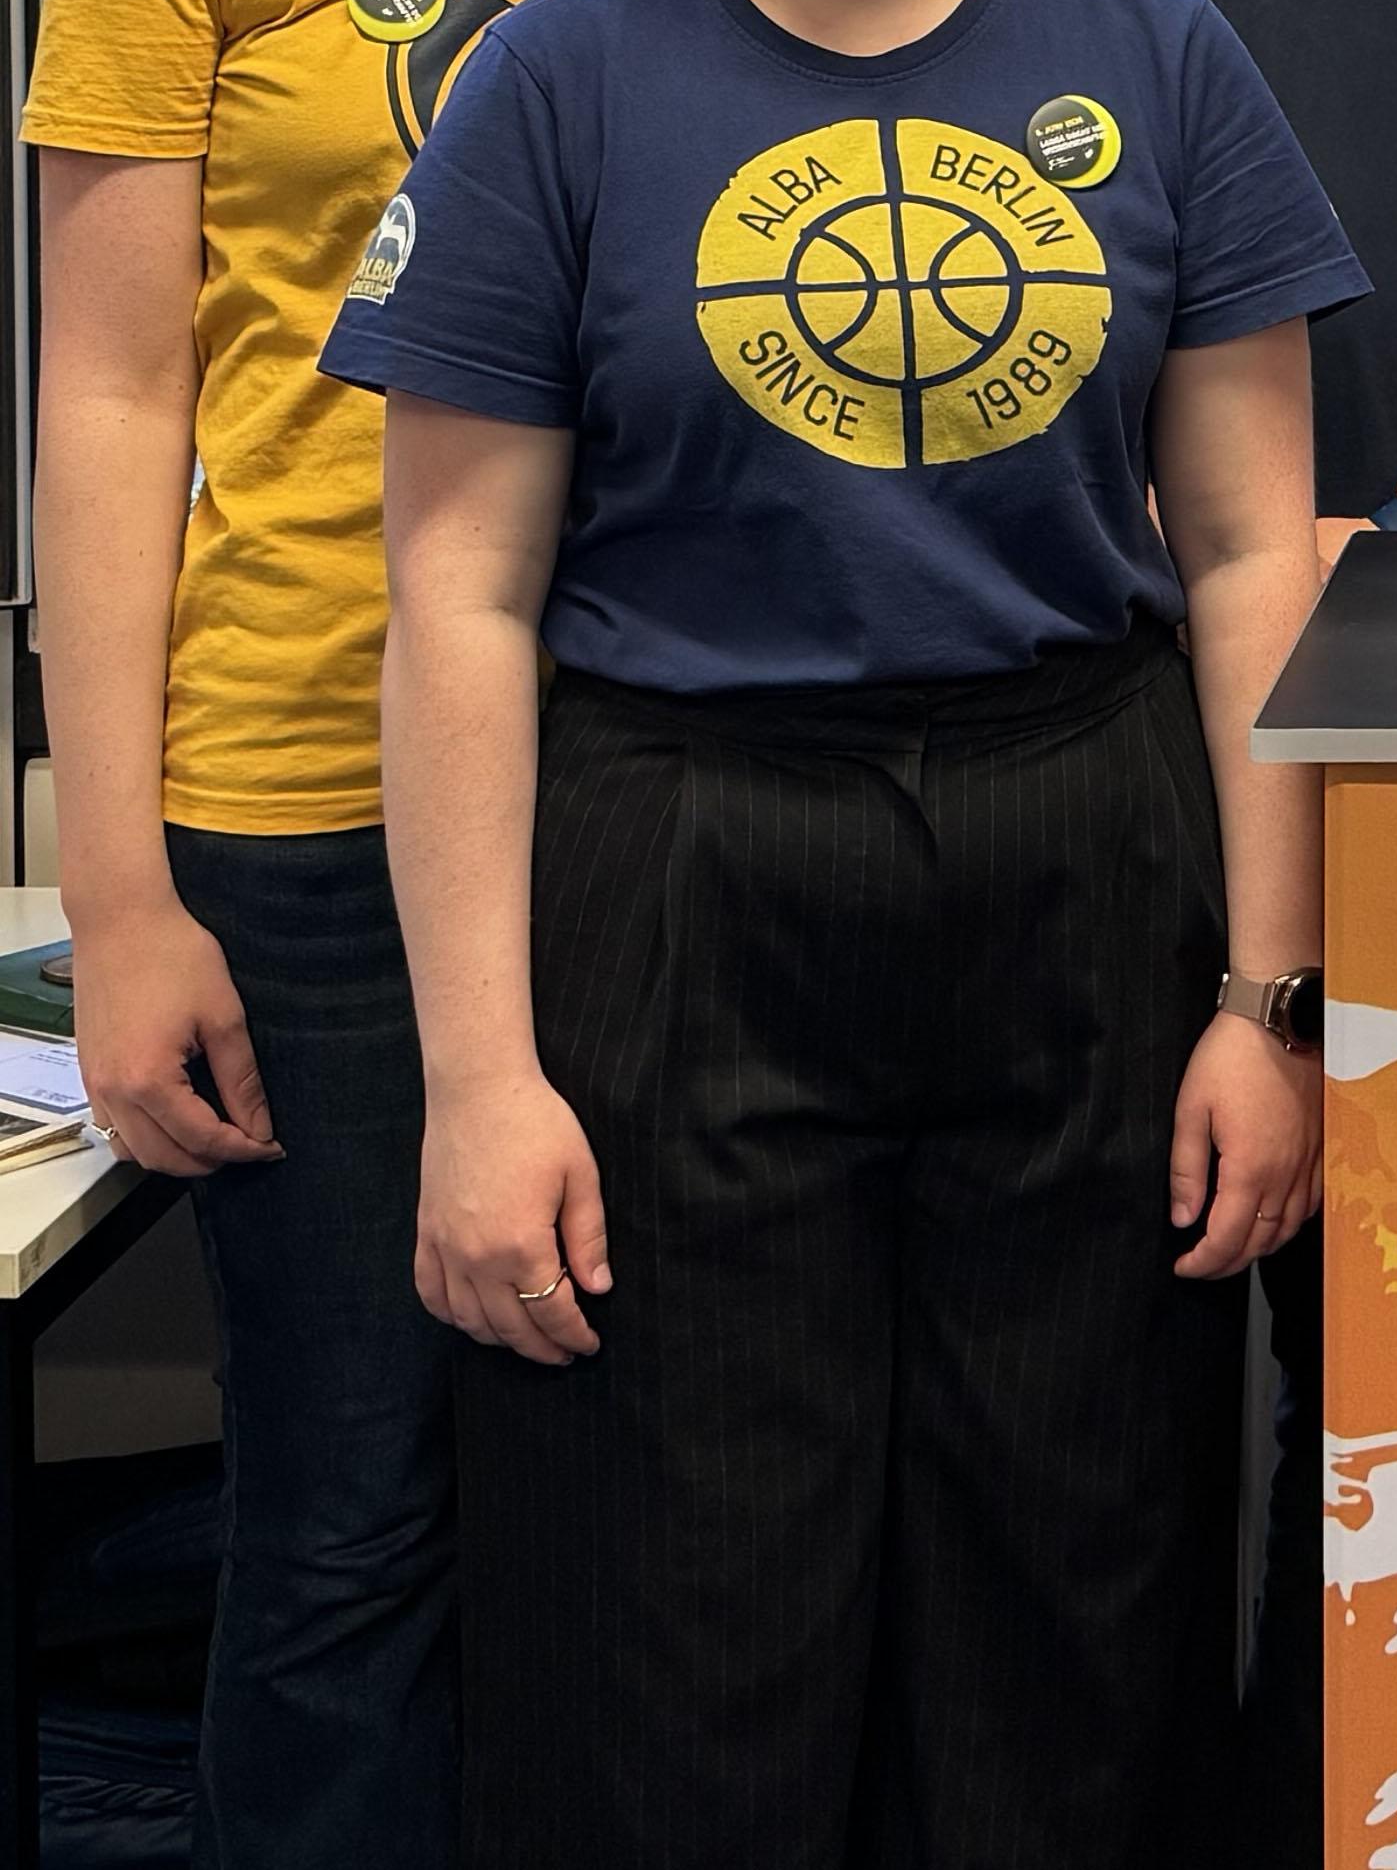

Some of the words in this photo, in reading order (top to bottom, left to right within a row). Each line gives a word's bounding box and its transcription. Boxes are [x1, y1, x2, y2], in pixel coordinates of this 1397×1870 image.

[737, 156, 842, 241] ALBA
[930, 144, 1075, 247] BERLIN
[739, 330, 865, 441] SINCE
[966, 329, 1073, 429] 1989
